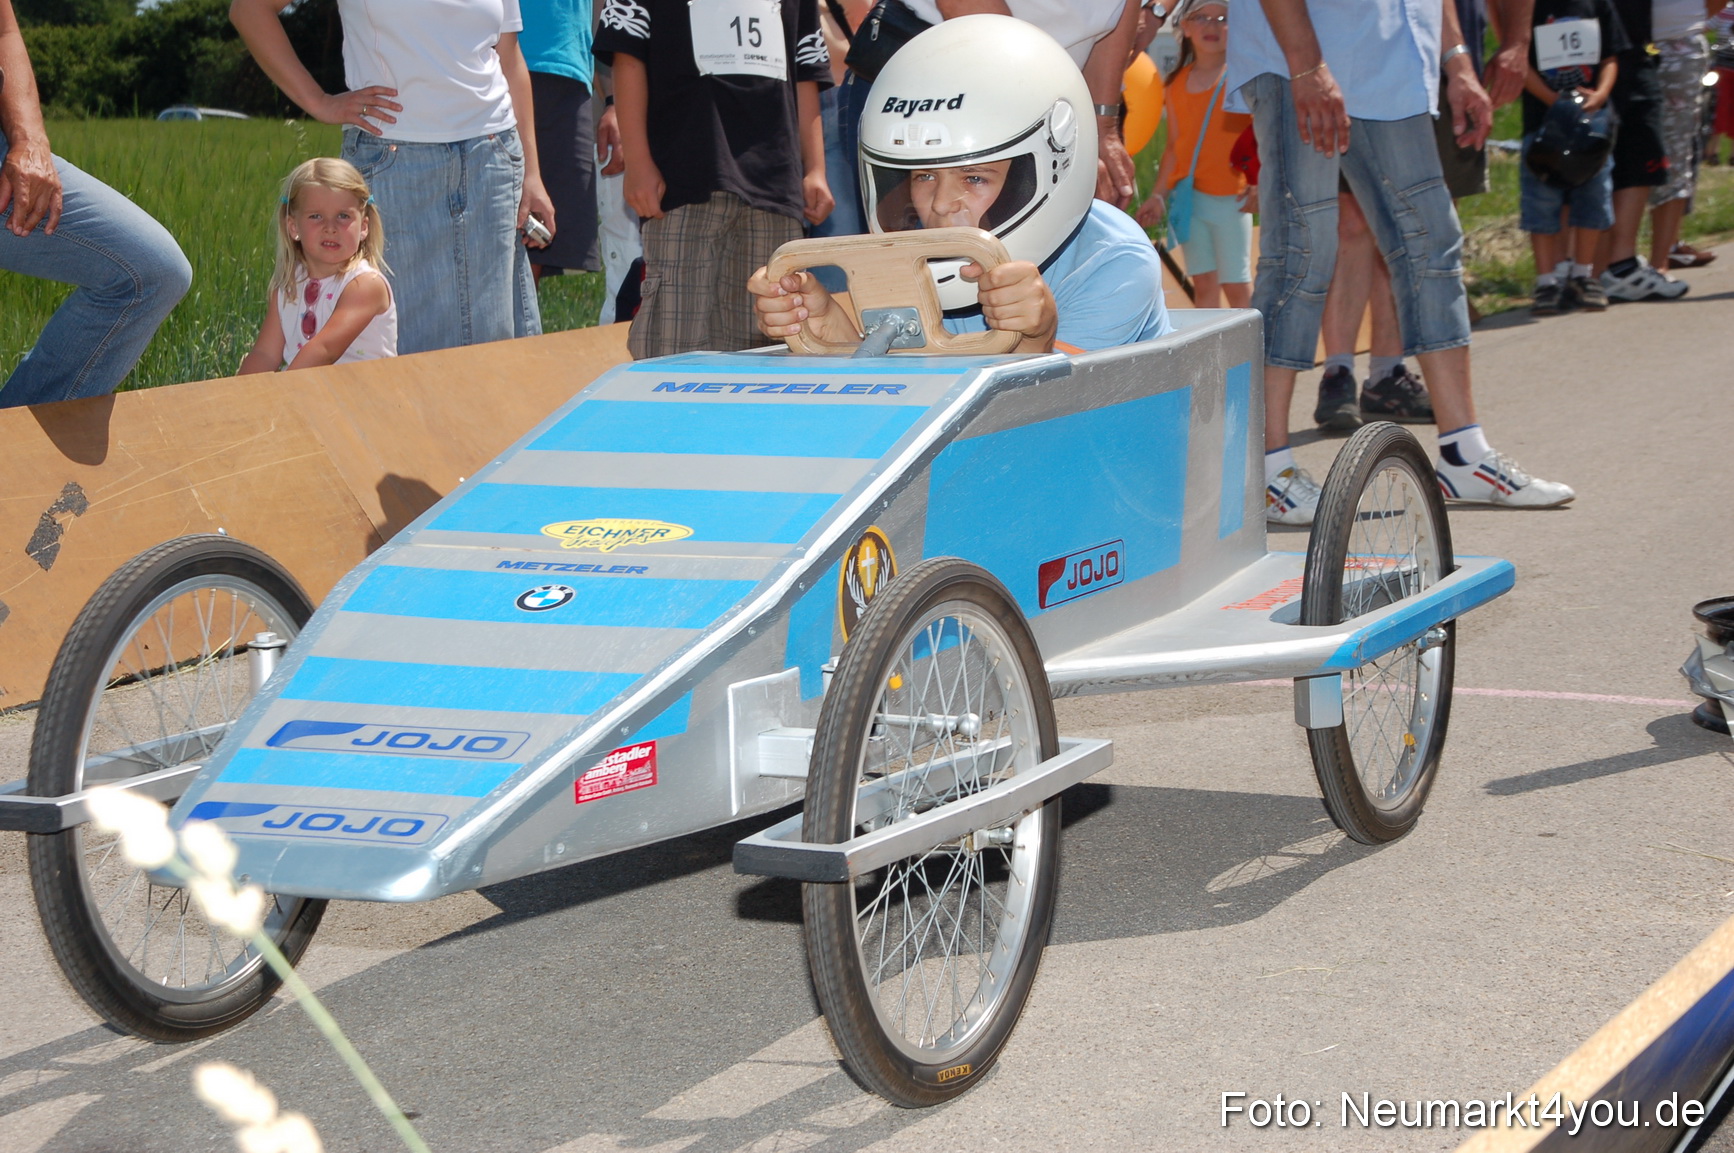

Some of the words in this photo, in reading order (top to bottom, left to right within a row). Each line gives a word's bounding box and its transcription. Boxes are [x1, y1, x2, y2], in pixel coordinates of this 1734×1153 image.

[730, 16, 762, 48] 15
[1559, 32, 1581, 51] 16
[881, 93, 965, 118] Bayard
[651, 382, 907, 395] METZELER
[563, 525, 671, 539] EICHNER
[496, 560, 649, 575] METZELER
[1067, 550, 1119, 590] JOJO
[351, 731, 509, 753] JOJO
[262, 812, 425, 837] JOJO
[939, 1066, 968, 1081] KENDA
